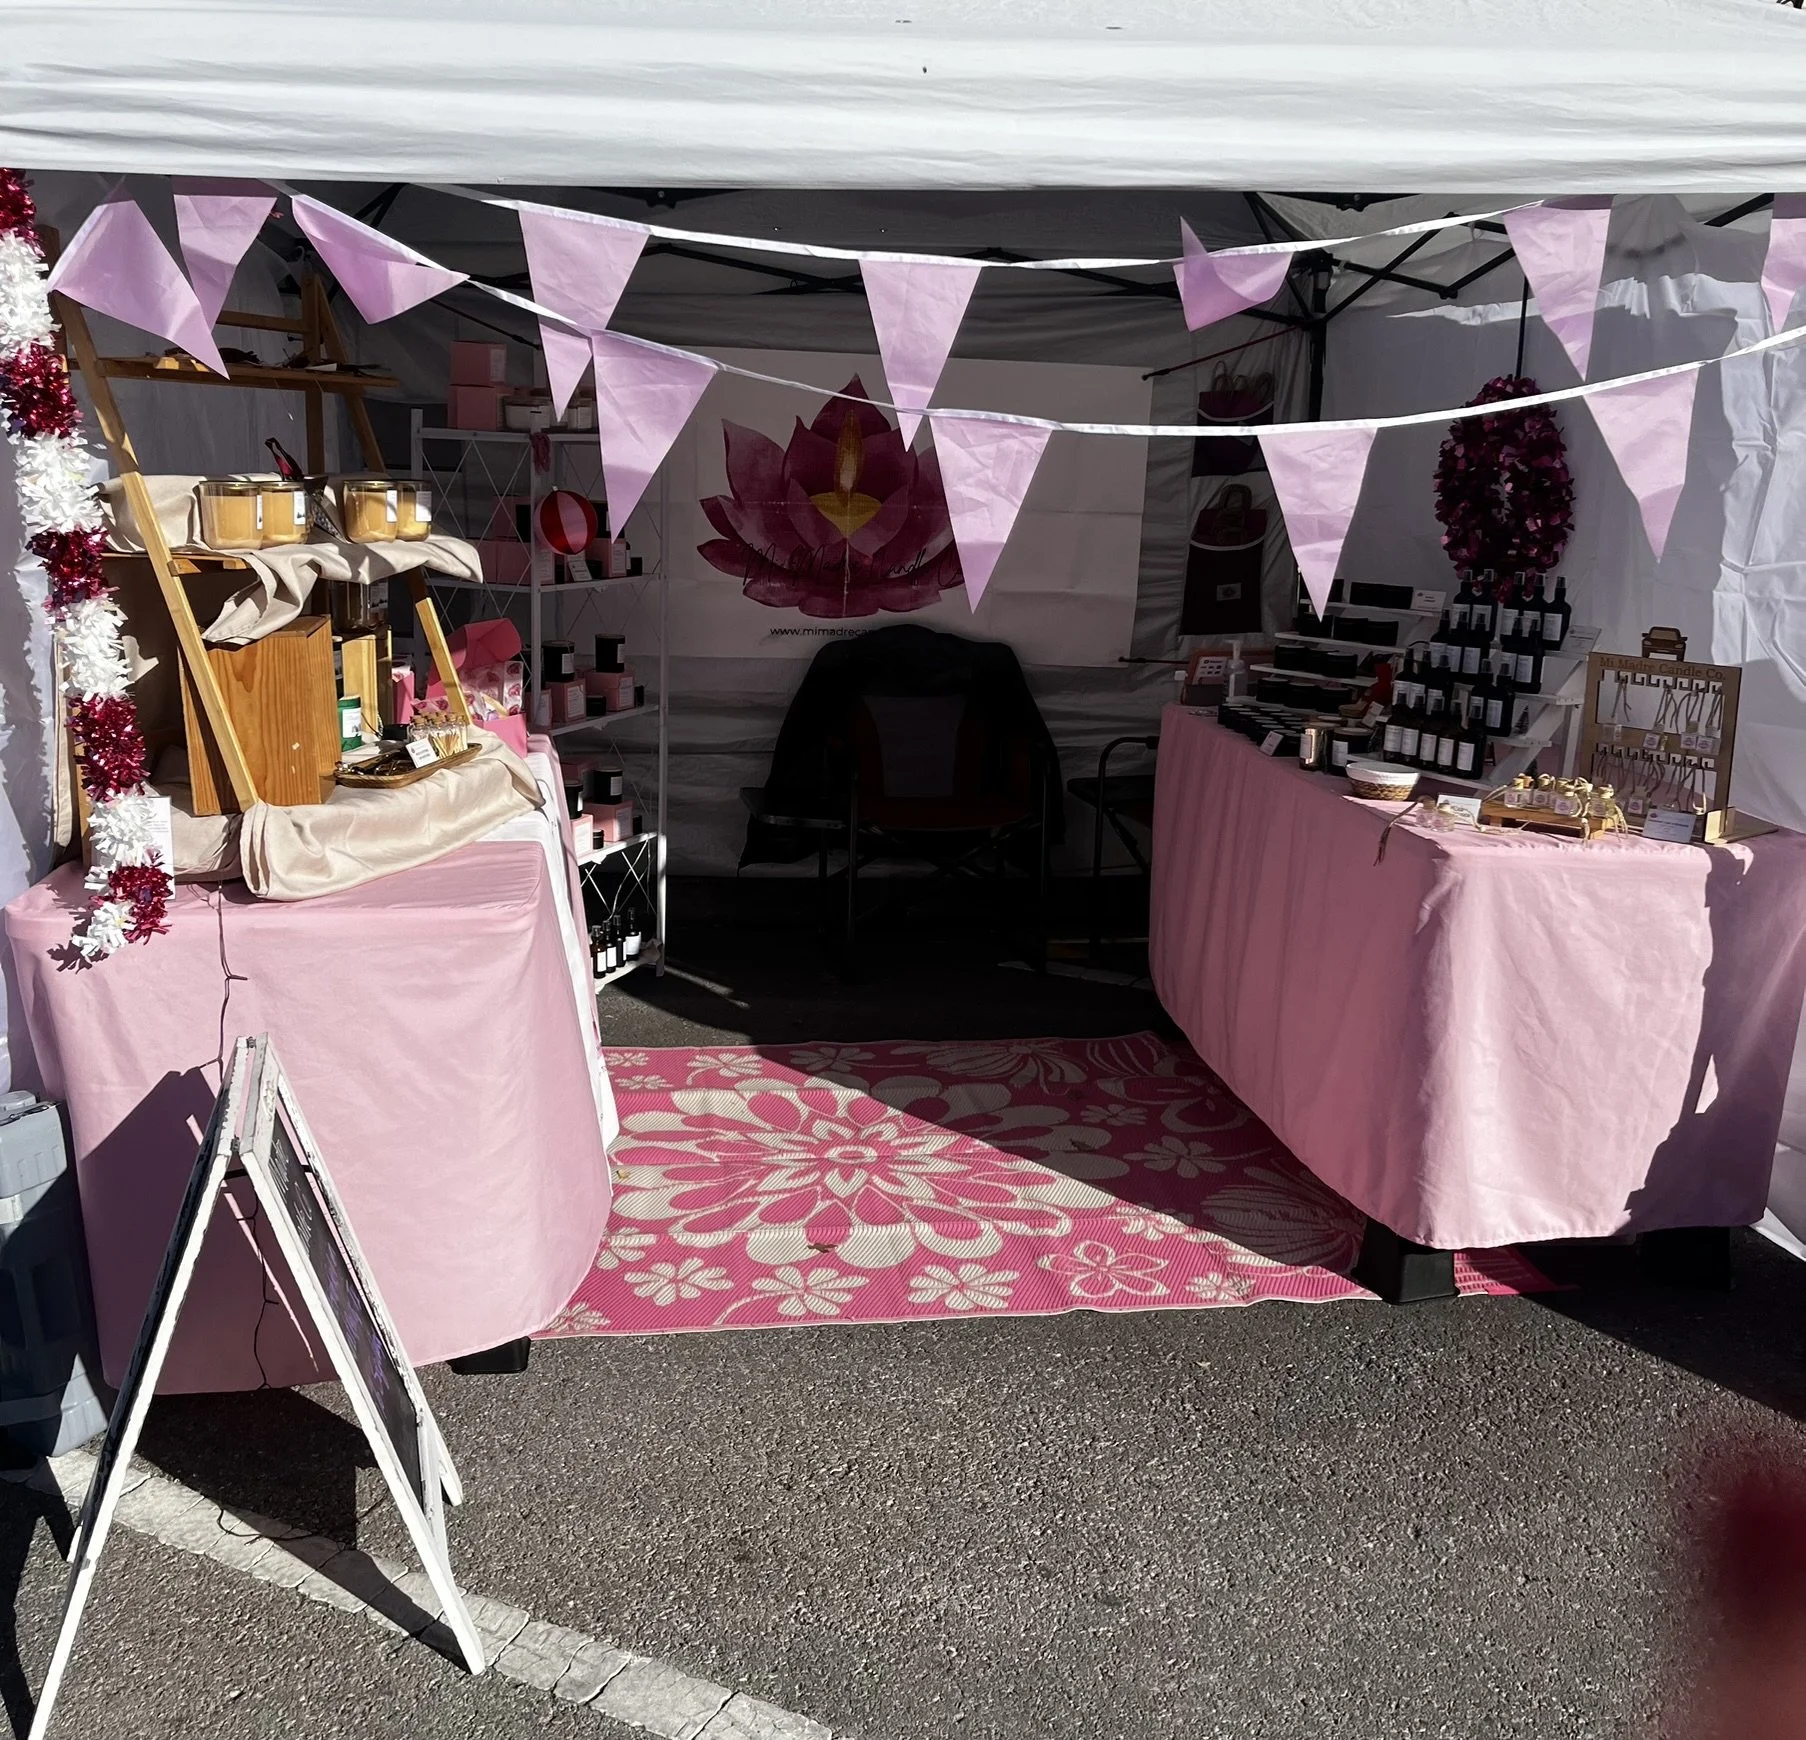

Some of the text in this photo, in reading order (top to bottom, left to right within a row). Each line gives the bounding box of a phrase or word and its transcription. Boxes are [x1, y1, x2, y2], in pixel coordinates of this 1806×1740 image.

[1599, 656, 1614, 668] Mi
[1617, 659, 1655, 671] Madre
[1658, 663, 1702, 677] Candle
